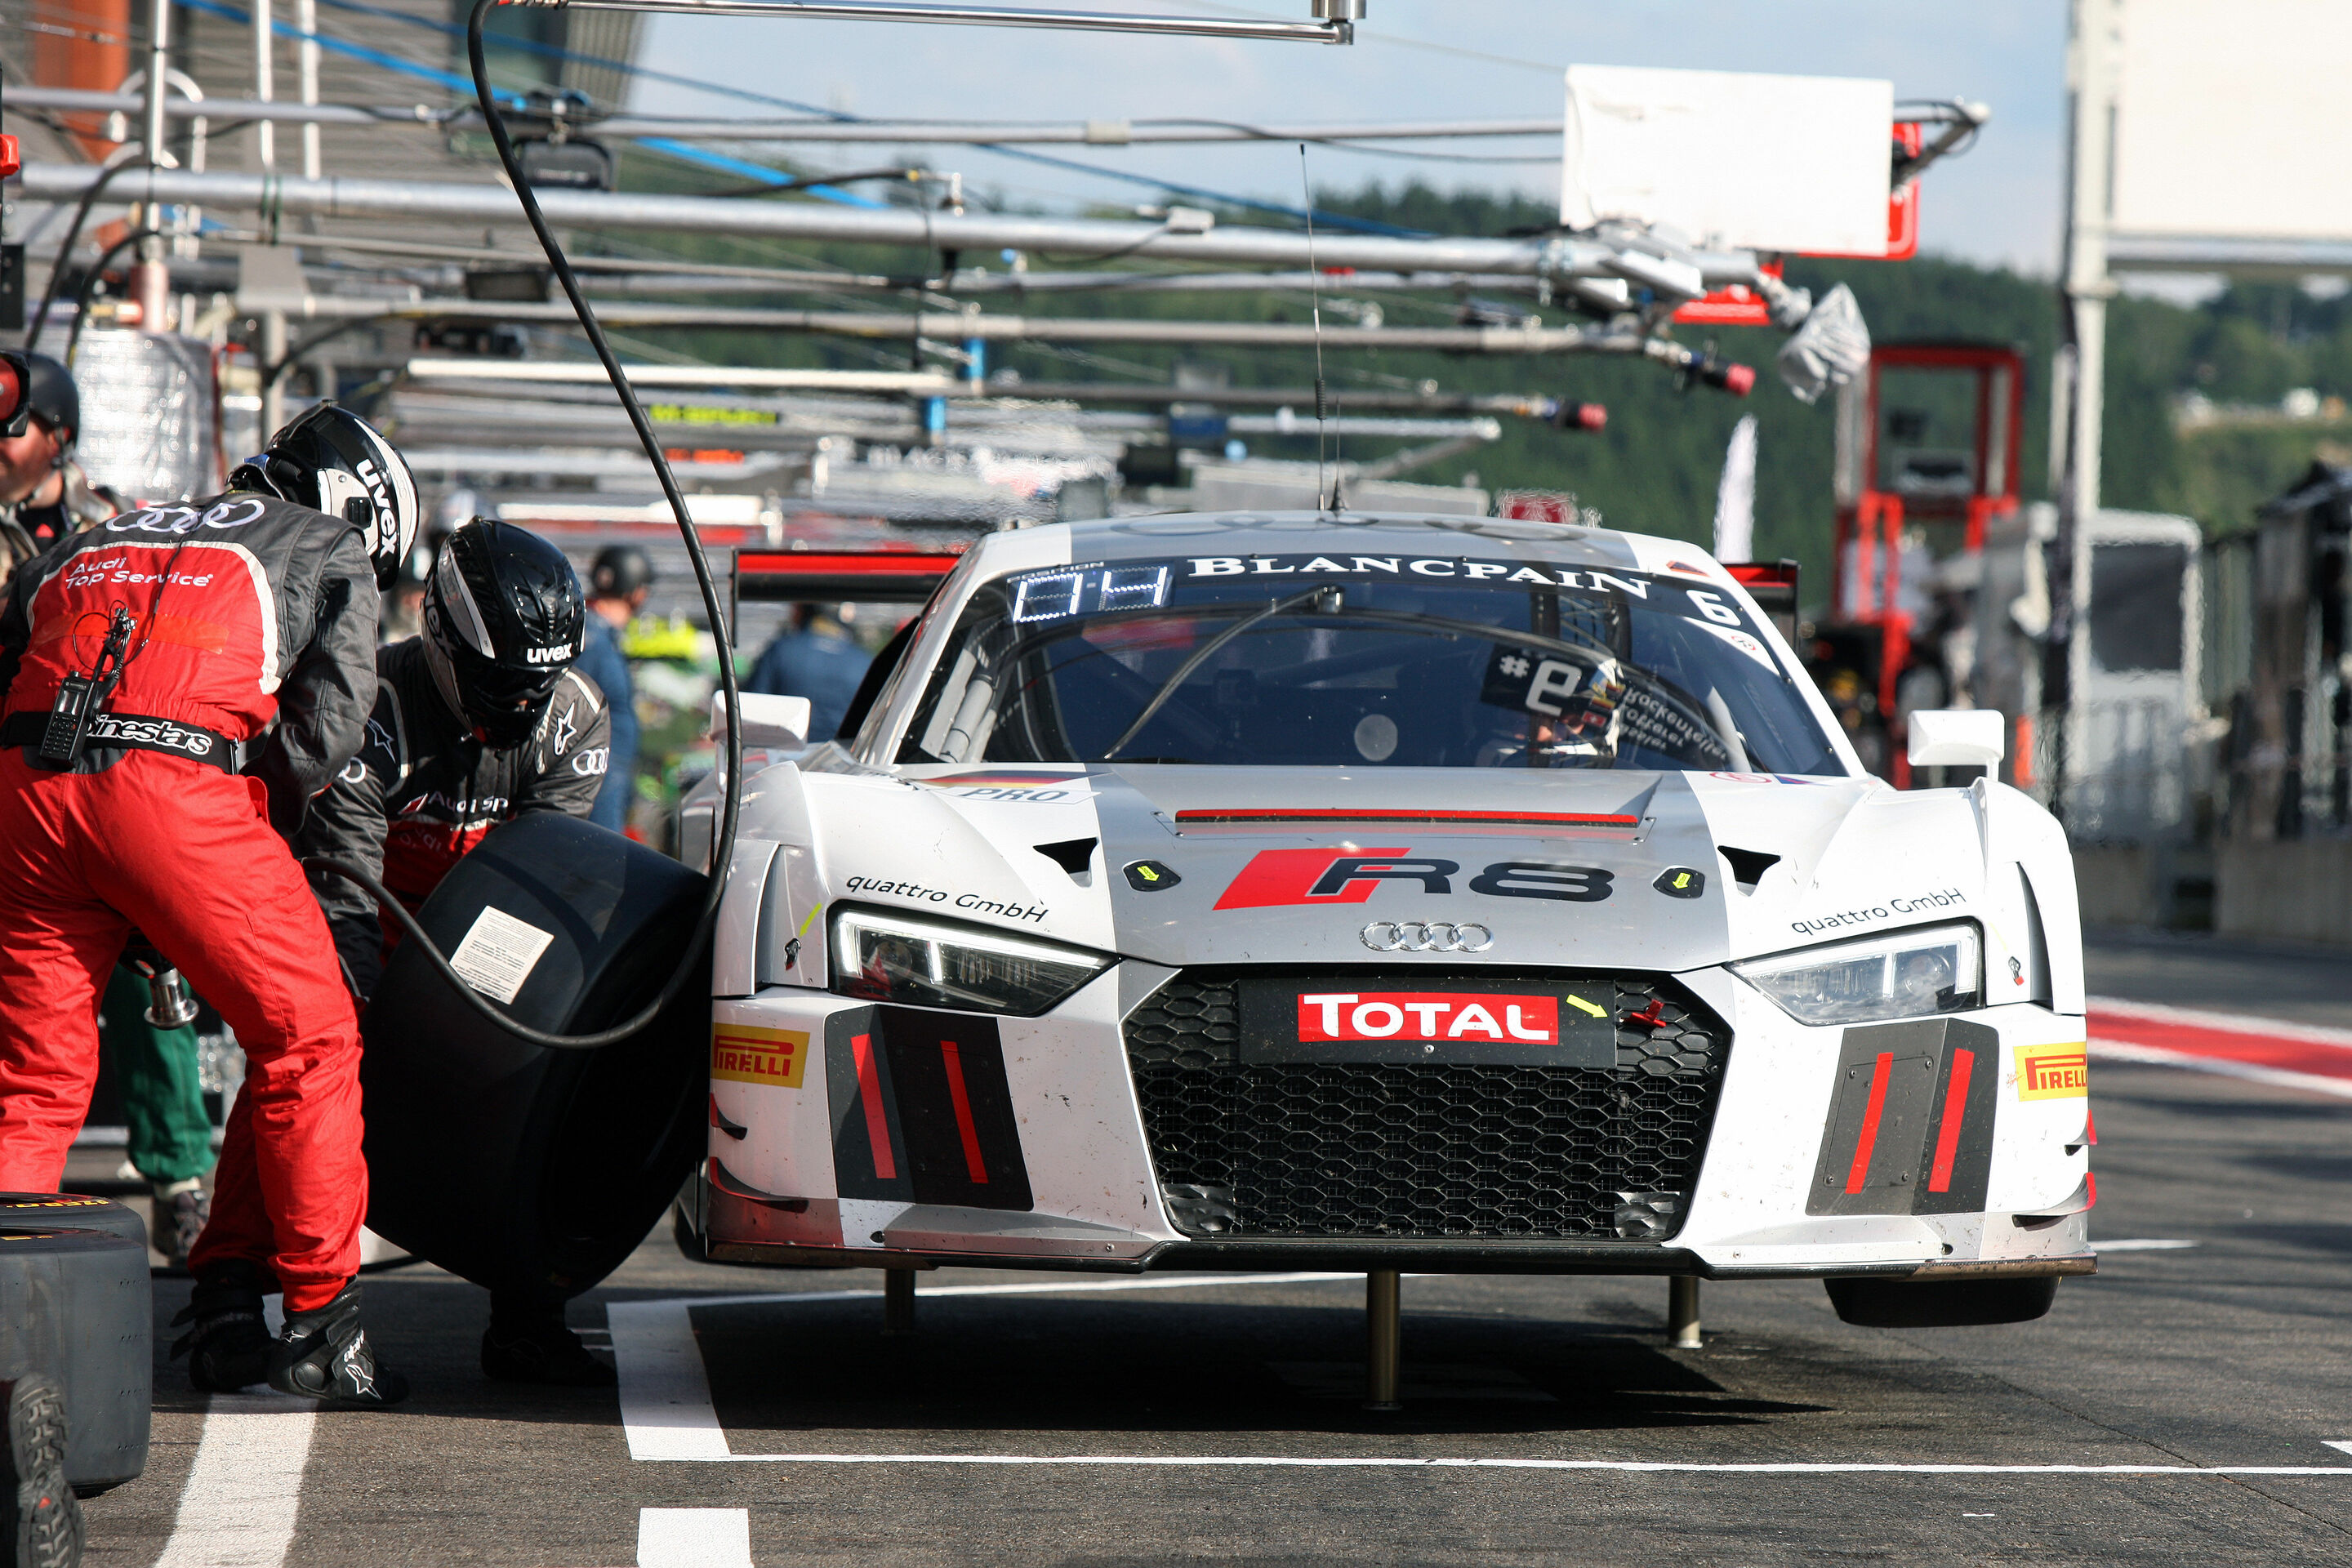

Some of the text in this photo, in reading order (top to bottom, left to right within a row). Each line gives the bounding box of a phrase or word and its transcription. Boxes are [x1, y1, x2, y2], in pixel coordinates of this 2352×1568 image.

[356, 459, 397, 558] uvex
[65, 572, 105, 590] Top
[69, 557, 127, 577] Audi
[1187, 556, 1651, 599] BLANCPAIN
[1686, 590, 1742, 626] 6
[527, 643, 572, 663] uvex
[959, 788, 1070, 801] PRO
[846, 875, 1049, 922] quattro GmbH
[1310, 858, 1615, 902] R8
[1791, 888, 1967, 936] quattro GmbH
[1303, 994, 1549, 1040] TOTAL
[713, 1034, 795, 1076] PIRELLI
